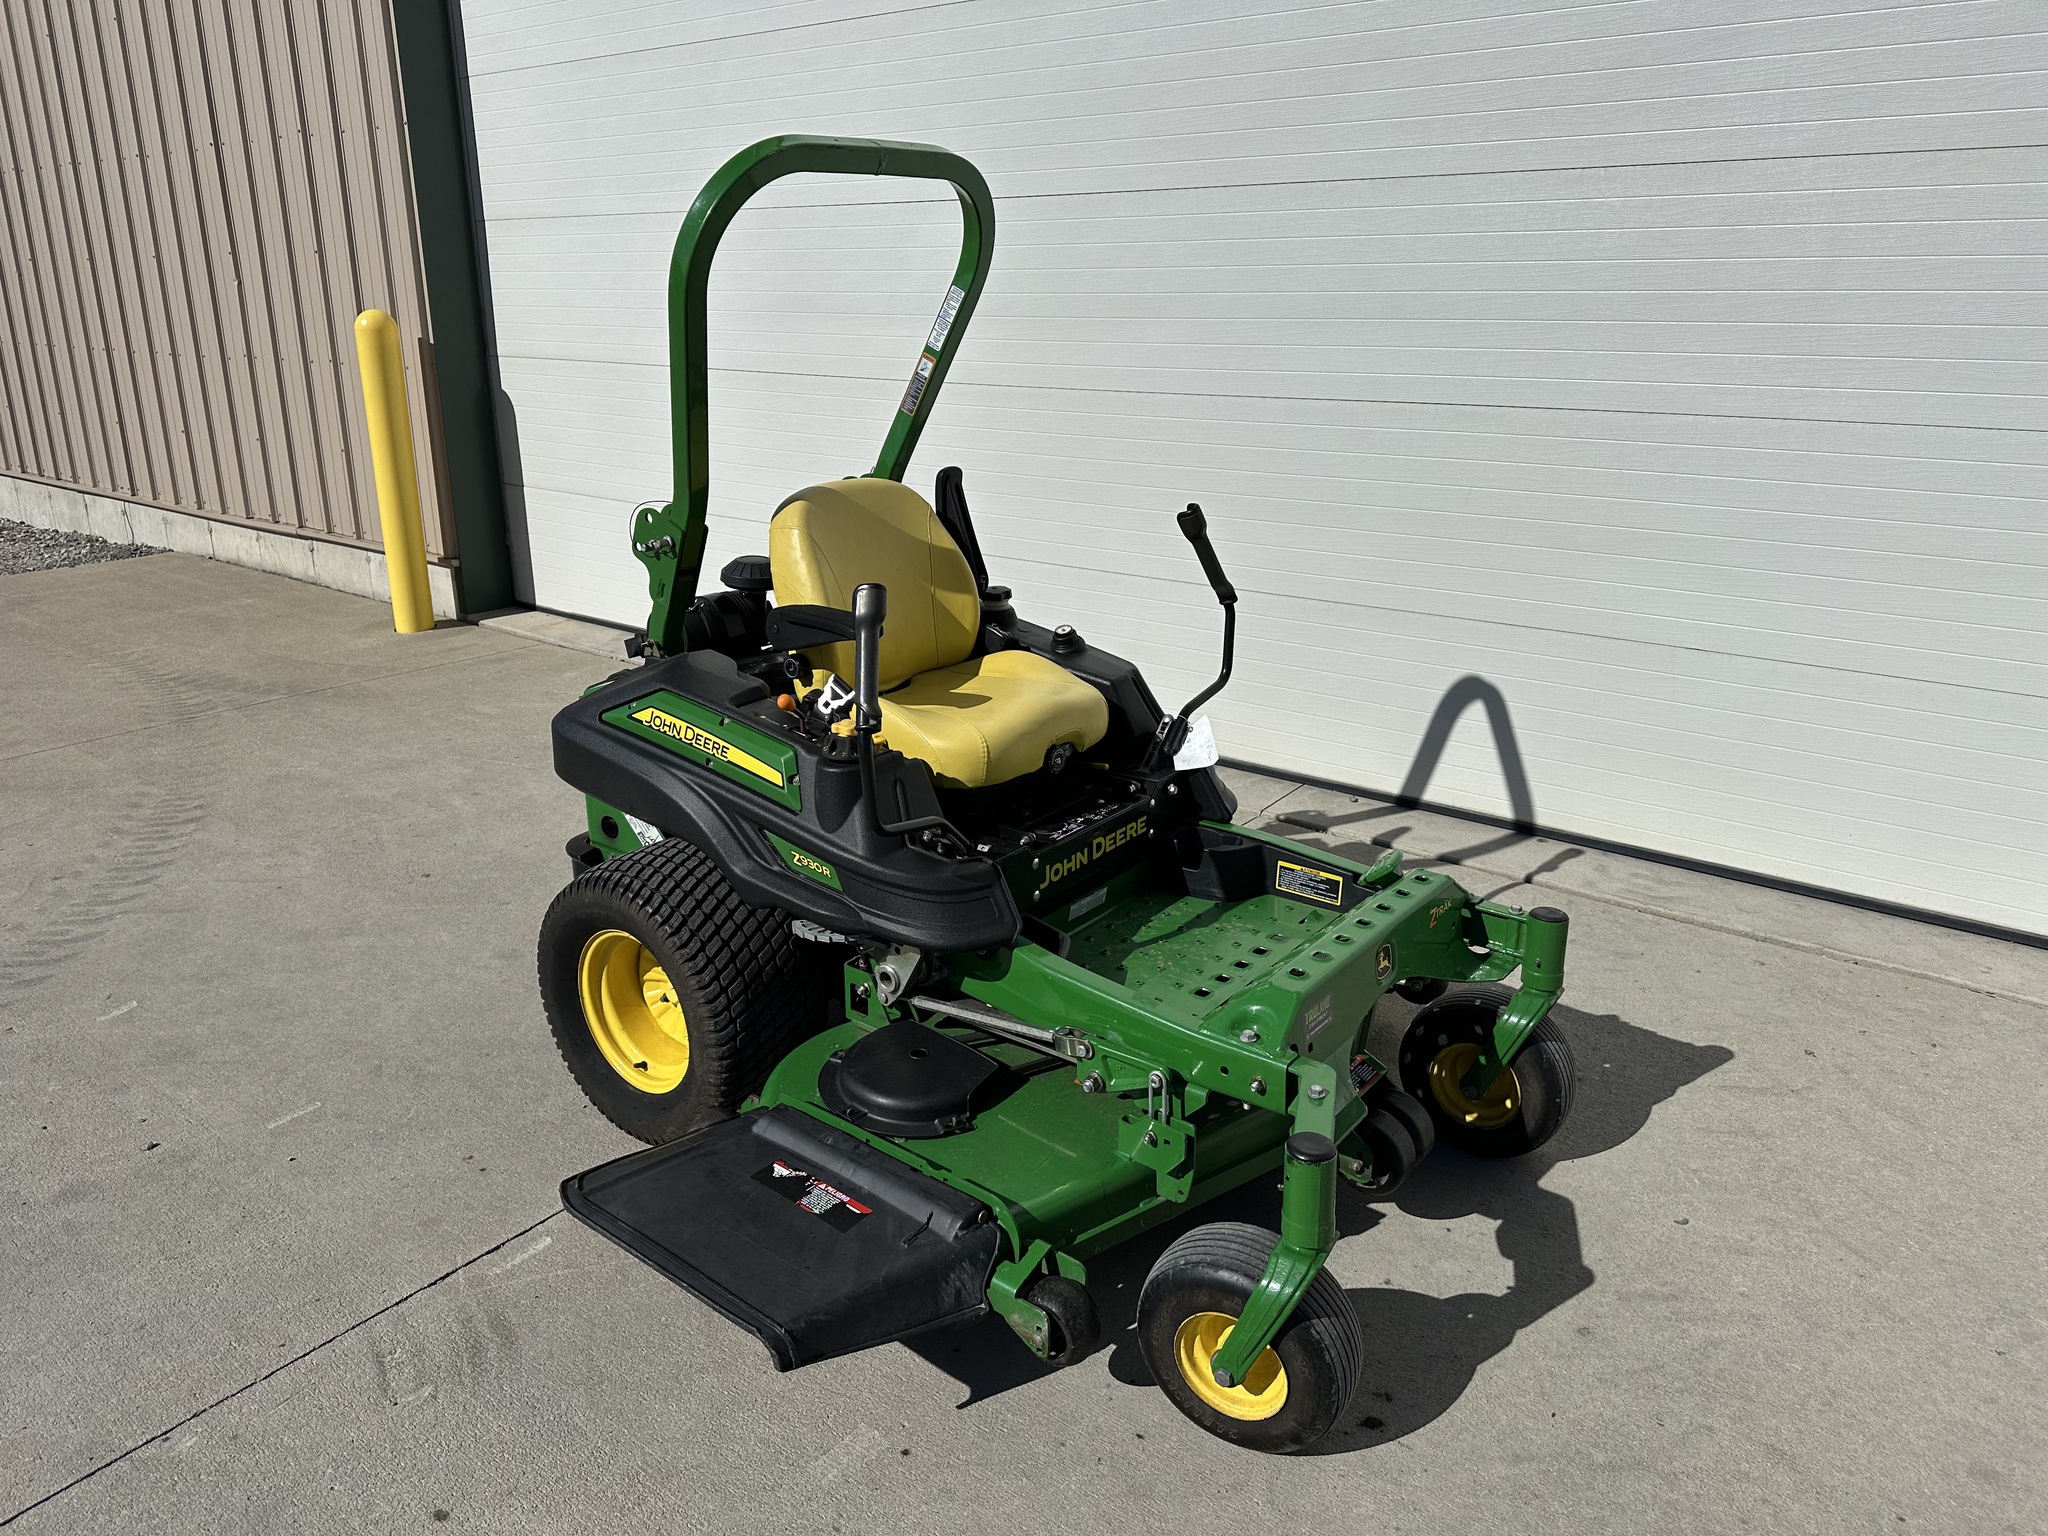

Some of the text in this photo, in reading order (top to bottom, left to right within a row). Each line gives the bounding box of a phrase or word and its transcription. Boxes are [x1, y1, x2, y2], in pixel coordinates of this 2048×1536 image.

[644, 710, 730, 760] JOHN DEERE
[790, 850, 831, 878] Z930R
[1040, 847, 1088, 889] JOHN
[1092, 815, 1147, 860] DEERE
[825, 1185, 850, 1202] PELIGRO
